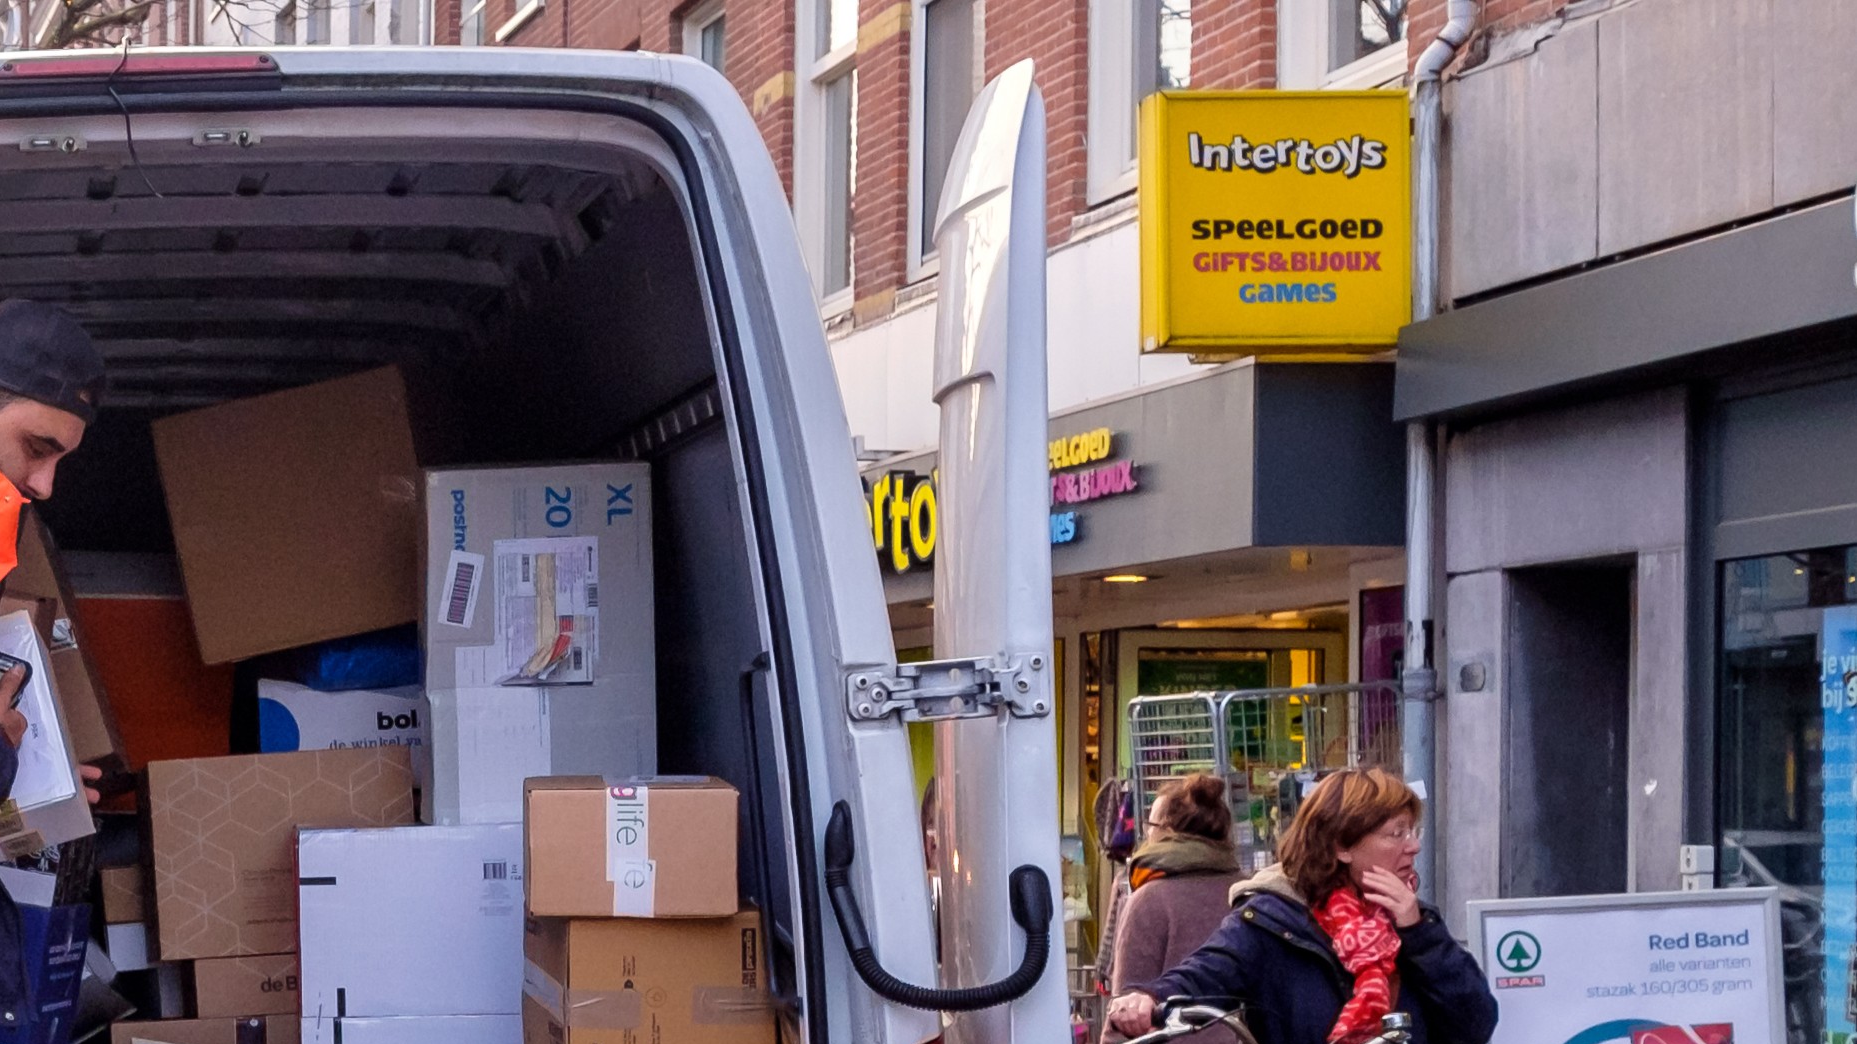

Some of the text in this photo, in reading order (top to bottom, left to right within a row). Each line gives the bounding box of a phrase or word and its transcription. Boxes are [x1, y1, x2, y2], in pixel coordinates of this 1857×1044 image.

[1189, 132, 1387, 178] Intertoys
[545, 486, 572, 528] 20
[607, 483, 633, 526] XL
[1650, 930, 1750, 950] Red Band
[1650, 957, 1751, 973] alle varianten
[1586, 978, 1753, 998] stazak 160/305 gram
